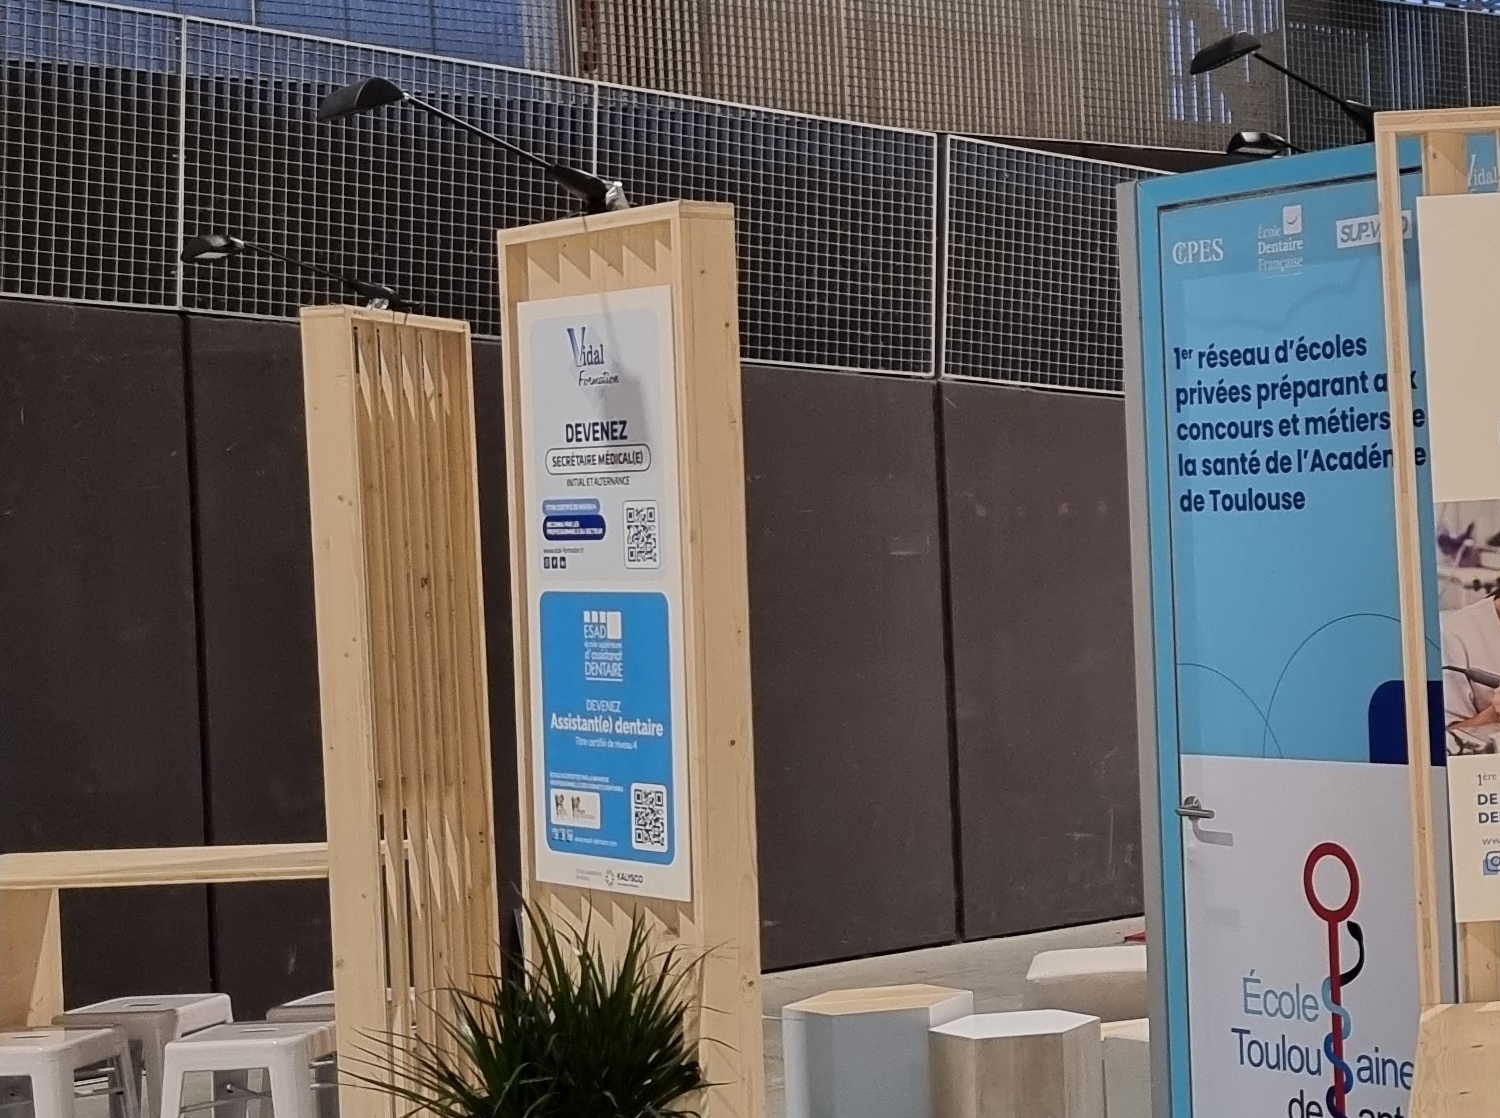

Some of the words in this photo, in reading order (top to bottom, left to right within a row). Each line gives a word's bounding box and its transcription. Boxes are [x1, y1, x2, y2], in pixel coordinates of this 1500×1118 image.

[1257, 224, 1281, 239] École
[1173, 239, 1224, 264] CPES
[1258, 238, 1303, 255] Dentaire
[1259, 255, 1303, 272] Française
[567, 327, 604, 367] Vidal
[1198, 343, 1270, 370] réseau
[1275, 334, 1367, 364] d'écoles
[1176, 379, 1251, 413] privées
[1257, 371, 1368, 410] préparant
[565, 420, 628, 443] DEVENEZ
[1177, 417, 1274, 441] concours
[1278, 414, 1299, 437] et
[1305, 407, 1391, 436] métiers
[552, 453, 597, 467] SECRÉTAIRE
[598, 450, 644, 466] MÉDICAL(E)
[1179, 453, 1197, 476] la
[1202, 450, 1260, 476] santé
[1265, 450, 1292, 475] de
[1180, 489, 1204, 512] de
[1209, 488, 1305, 512] Toulouse
[584, 625, 606, 638] ESAD
[585, 661, 623, 677] DENTAIRE
[586, 699, 621, 712] DEVENEZ
[551, 713, 613, 734] Assistant(e)
[615, 717, 664, 737] dentaire
[1477, 792, 1497, 805] DE
[617, 873, 643, 883] KALYSCO
